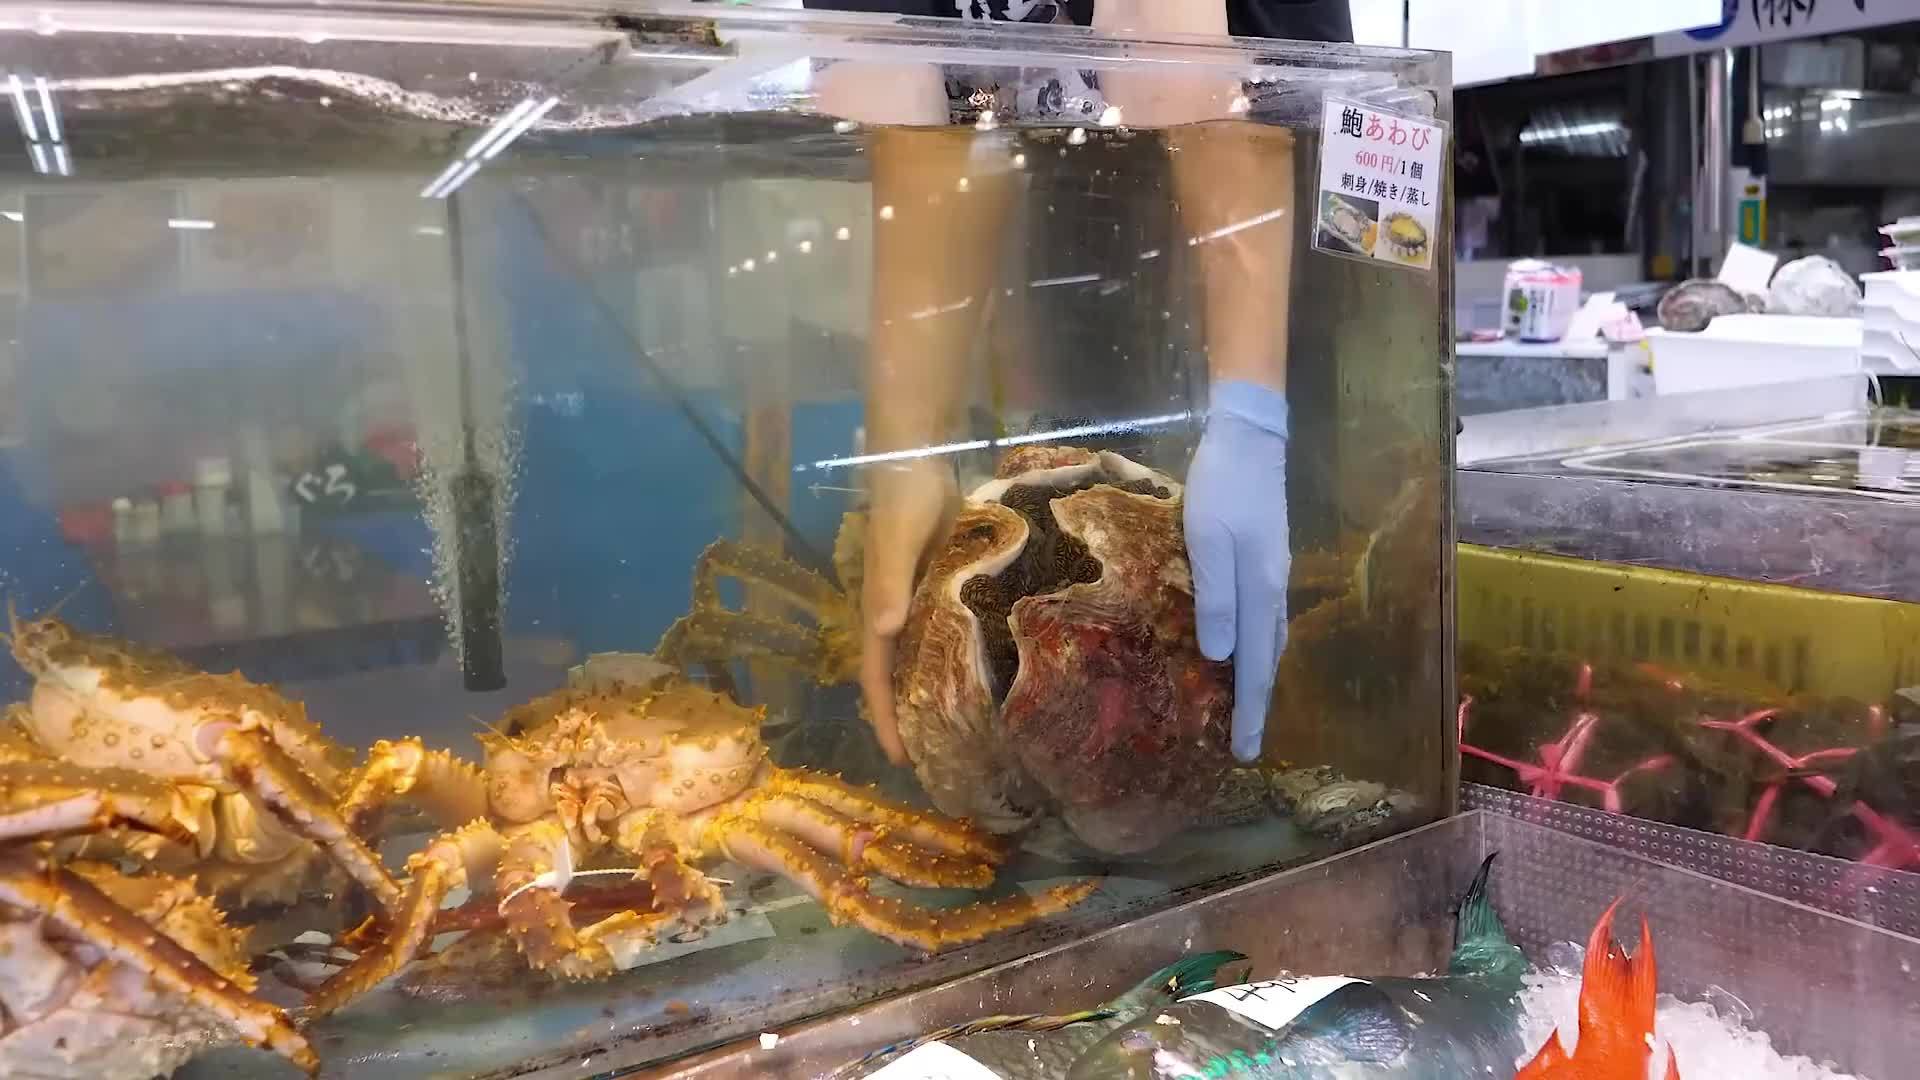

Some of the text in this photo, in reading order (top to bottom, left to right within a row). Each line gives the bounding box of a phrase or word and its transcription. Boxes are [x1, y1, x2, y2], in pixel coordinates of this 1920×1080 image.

[1340, 106, 1431, 151] 鮑あわび
[1341, 172, 1430, 207] 刺身/焼き/蒸し
